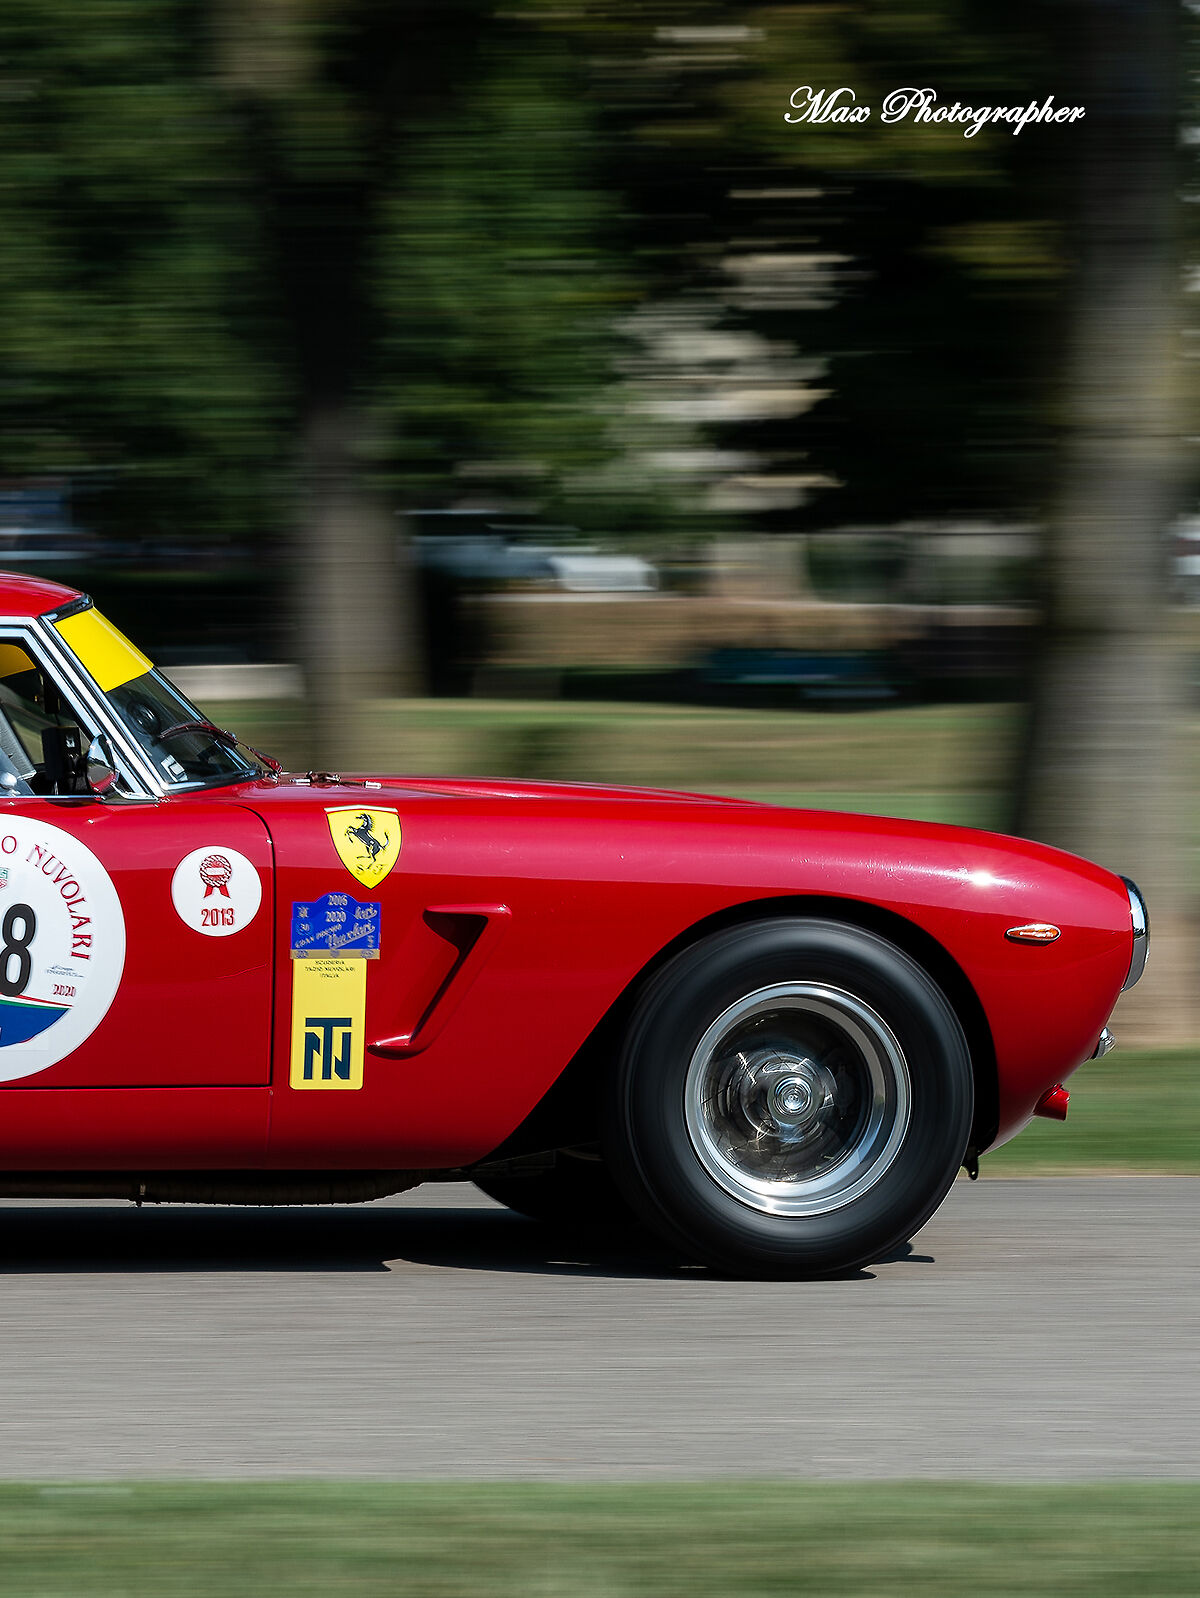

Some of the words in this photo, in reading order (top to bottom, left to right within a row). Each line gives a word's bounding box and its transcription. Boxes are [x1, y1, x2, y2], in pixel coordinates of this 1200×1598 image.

[25, 844, 93, 961] NUVOLARI
[200, 907, 235, 927] 2013
[52, 983, 77, 997] 2020
